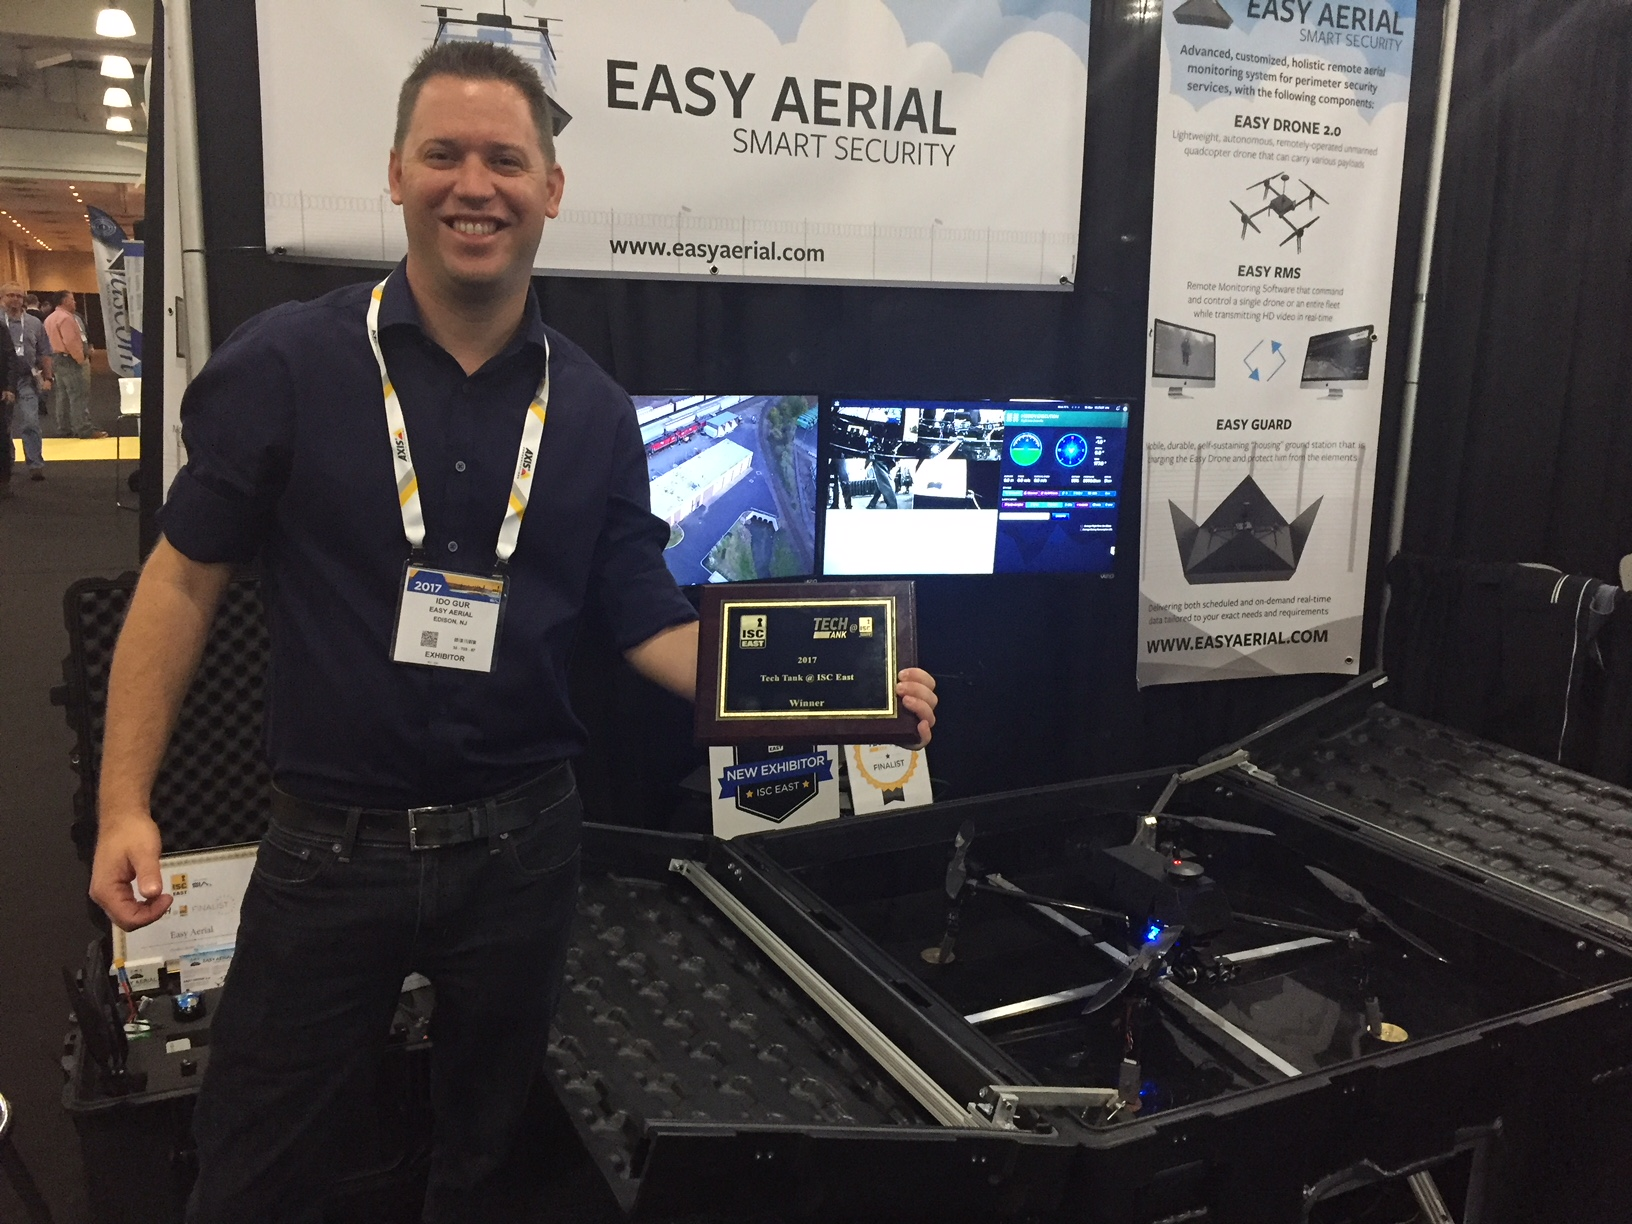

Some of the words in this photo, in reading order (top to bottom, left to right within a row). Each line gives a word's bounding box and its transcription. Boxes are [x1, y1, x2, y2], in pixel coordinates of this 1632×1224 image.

[1247, 0, 1312, 25] EASY
[1317, 3, 1404, 36] AERIAL
[1299, 28, 1342, 46] SMART
[1346, 33, 1403, 51] SECURITY
[1180, 44, 1234, 61] Advanced,
[1235, 51, 1290, 69] customized,
[1292, 57, 1325, 71] holistic
[1328, 62, 1362, 75] remote
[1364, 66, 1386, 77] aerial
[1187, 64, 1243, 81] monitoring
[1245, 71, 1277, 85] system
[1280, 72, 1293, 84] for
[1295, 76, 1341, 90] perimeter
[1344, 80, 1378, 95] security
[606, 58, 756, 119] EASY
[771, 76, 957, 136] AERIAL
[1187, 81, 1232, 96] services,
[1234, 85, 1255, 97] with
[1257, 87, 1273, 98] the
[1274, 88, 1316, 105] following
[1319, 94, 1375, 110] components:
[1234, 114, 1270, 130] EASY
[1273, 118, 1320, 136] DRONE
[1323, 125, 1342, 137] 2.0
[733, 127, 827, 158] SMART
[834, 135, 956, 167] SECURITY
[1172, 130, 1222, 144] Lightweight,
[1223, 134, 1275, 148] autonomous,
[1276, 138, 1343, 153] remotely-operated
[1184, 146, 1231, 158] quadcopter
[1233, 149, 1257, 160] drone
[1258, 151, 1275, 161] that
[1276, 154, 1290, 162] can
[1291, 154, 1310, 166] carry
[610, 238, 825, 264] www.easyaerial.com
[1237, 265, 1272, 278] EASY
[1274, 267, 1302, 279] RMS
[1187, 281, 1217, 292] Remote
[1218, 282, 1261, 295] Monitoring
[1262, 284, 1295, 294] Software
[1296, 286, 1311, 295] that
[1312, 287, 1344, 296] command
[1187, 295, 1202, 304] and
[1203, 296, 1232, 306] control
[1239, 297, 1261, 308] single
[1262, 298, 1285, 307] drone
[1306, 300, 1325, 309] entire
[1325, 300, 1341, 309] fleet
[1194, 310, 1213, 319] while
[1215, 310, 1261, 322] transmitting
[1262, 312, 1275, 321] HD
[1276, 312, 1296, 321] video
[1297, 313, 1304, 321] in
[1304, 313, 1333, 322] real-time
[1216, 419, 1249, 431] EASY
[1251, 418, 1292, 431] GUARD
[396, 437, 408, 462] AXIS
[1167, 441, 1197, 451] durable,
[1198, 441, 1250, 453] self-sustaining
[1285, 441, 1310, 452] ground
[1311, 441, 1337, 450] station
[1339, 440, 1356, 449] that
[522, 447, 534, 472] AXIS
[1176, 454, 1188, 463] the
[1189, 455, 1206, 465] Easy
[1207, 455, 1232, 464] Drone
[1232, 454, 1246, 463] and
[1247, 455, 1273, 465] protect
[1274, 454, 1287, 463] him
[1288, 454, 1306, 463] from
[1307, 453, 1320, 462] the
[413, 580, 442, 593] 2017
[436, 597, 451, 606] IDO
[453, 600, 470, 609] GUR
[1184, 600, 1201, 610] both
[1202, 599, 1239, 609] scheduled
[1240, 598, 1254, 607] and
[1255, 596, 1296, 606] on-demand
[1297, 595, 1332, 604] real-time
[429, 606, 448, 616] EASY
[448, 608, 473, 618] AERIAL
[1148, 616, 1163, 625] data
[1194, 614, 1202, 622] to
[1202, 613, 1219, 623] your
[1221, 611, 1240, 620] exact
[1241, 610, 1263, 619] needs
[1263, 609, 1278, 618] and
[1279, 607, 1329, 619] requirements
[433, 616, 459, 625] EDISON,
[813, 617, 849, 631] TECH
[742, 629, 765, 638] ISC
[849, 623, 858, 633] @
[741, 640, 766, 648] EAST
[1147, 629, 1329, 653] WWW.EASYAERIAL.COM
[425, 651, 465, 663] EXHIBITOR
[797, 656, 817, 664] 2017
[760, 674, 780, 682] Tech
[782, 674, 803, 682] Tank
[805, 674, 814, 683] @
[817, 674, 833, 682] ISC
[835, 673, 854, 682] East
[789, 699, 825, 708] Winner
[727, 766, 758, 781] NEW
[761, 755, 825, 776] EXHIBITOR
[873, 759, 905, 771] FINALIST
[756, 787, 773, 797] ISC
[774, 782, 799, 794] EAST
[172, 882, 188, 890] ISC
[170, 930, 188, 940] Easy
[191, 926, 214, 936] Aerial
